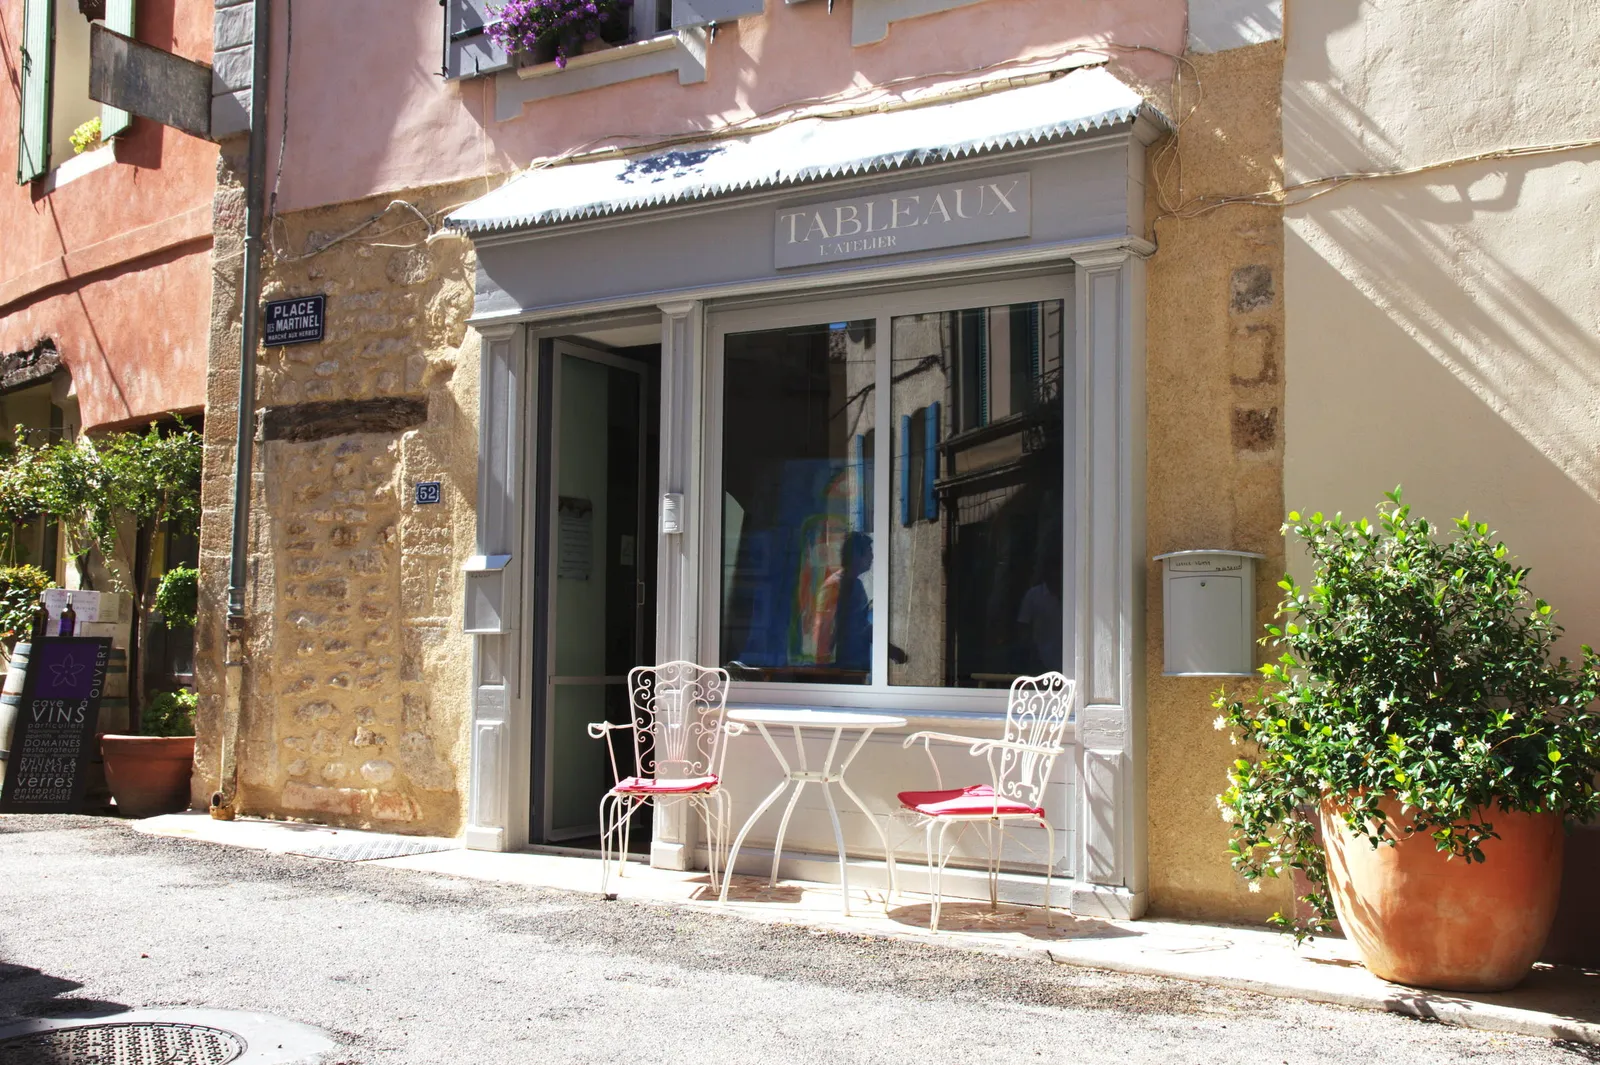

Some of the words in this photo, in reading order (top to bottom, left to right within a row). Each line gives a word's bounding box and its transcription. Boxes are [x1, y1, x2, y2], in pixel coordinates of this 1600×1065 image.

[780, 180, 1020, 244] TABLEAUX
[819, 235, 897, 257] L'ATELIER
[274, 302, 314, 318] PLACE
[276, 315, 319, 332] MARTINEL
[419, 486, 437, 500] 52
[89, 644, 108, 698] OUVERT
[32, 700, 64, 708] cave
[32, 707, 87, 723] VINS
[23, 740, 81, 748] DOMAINES
[19, 764, 76, 773] WHISKIES
[20, 757, 62, 767] RHUMS
[17, 777, 74, 788] verres
